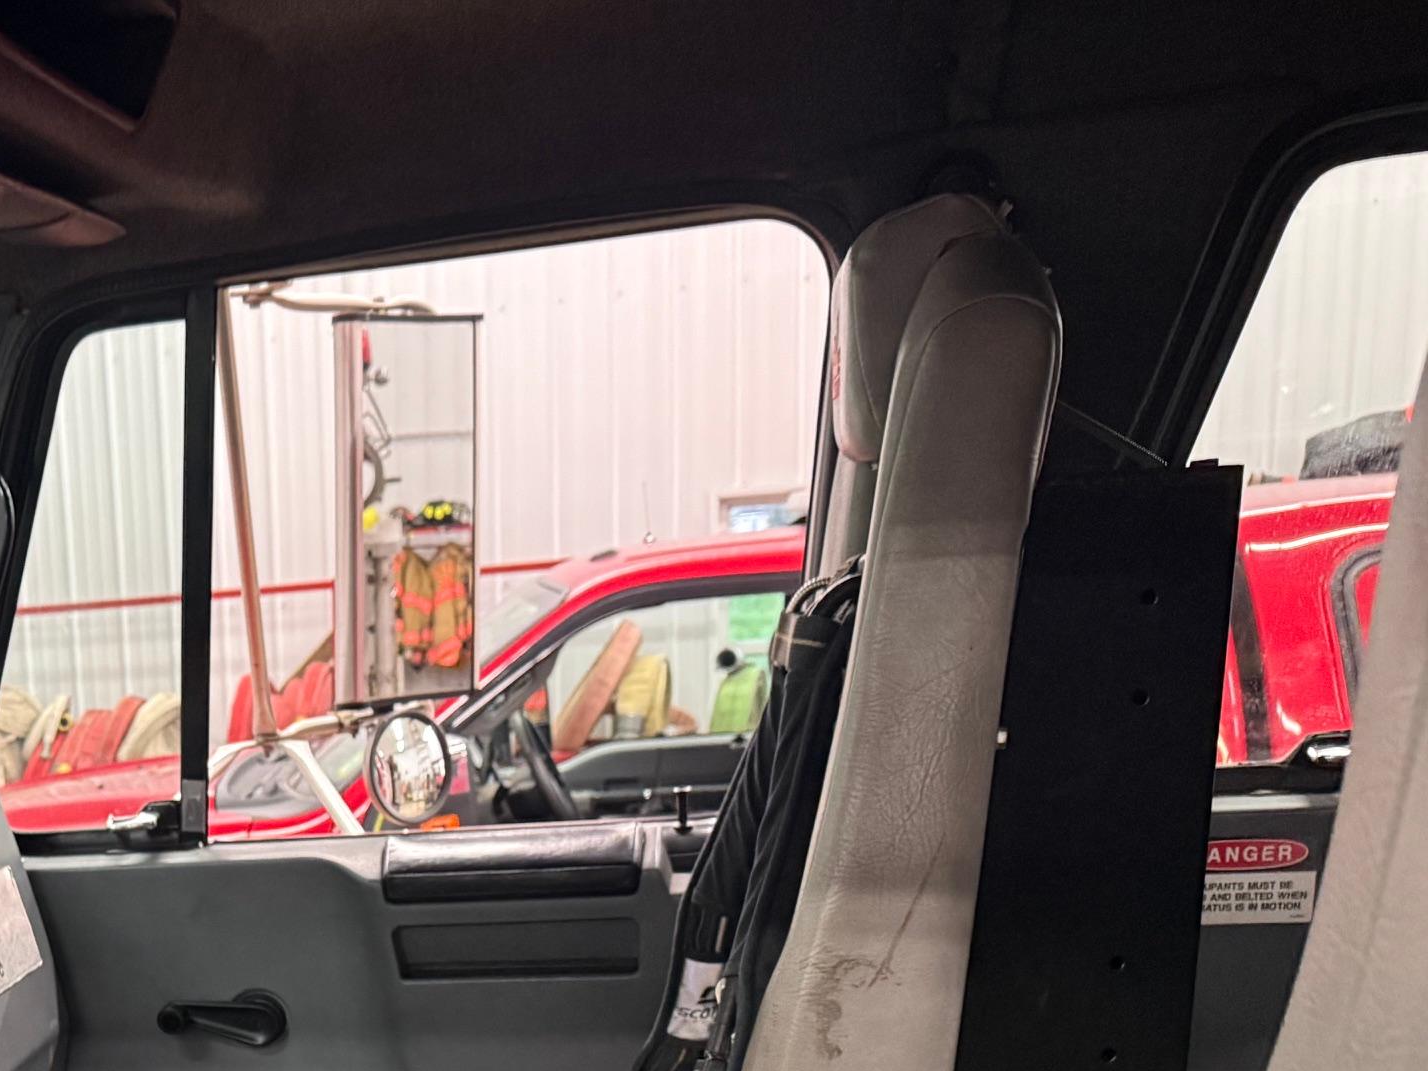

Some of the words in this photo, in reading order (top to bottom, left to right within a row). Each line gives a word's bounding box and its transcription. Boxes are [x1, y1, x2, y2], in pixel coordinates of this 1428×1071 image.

[1208, 844, 1292, 863] ANGER
[1247, 881, 1276, 890] MUST
[1279, 880, 1293, 889] BE
[1210, 892, 1231, 901] AND
[1235, 892, 1273, 901] BELTED
[1277, 891, 1308, 900] WHEN
[1234, 903, 1244, 912] IS
[1248, 902, 1258, 911] IN
[1260, 902, 1301, 911] MOTION
